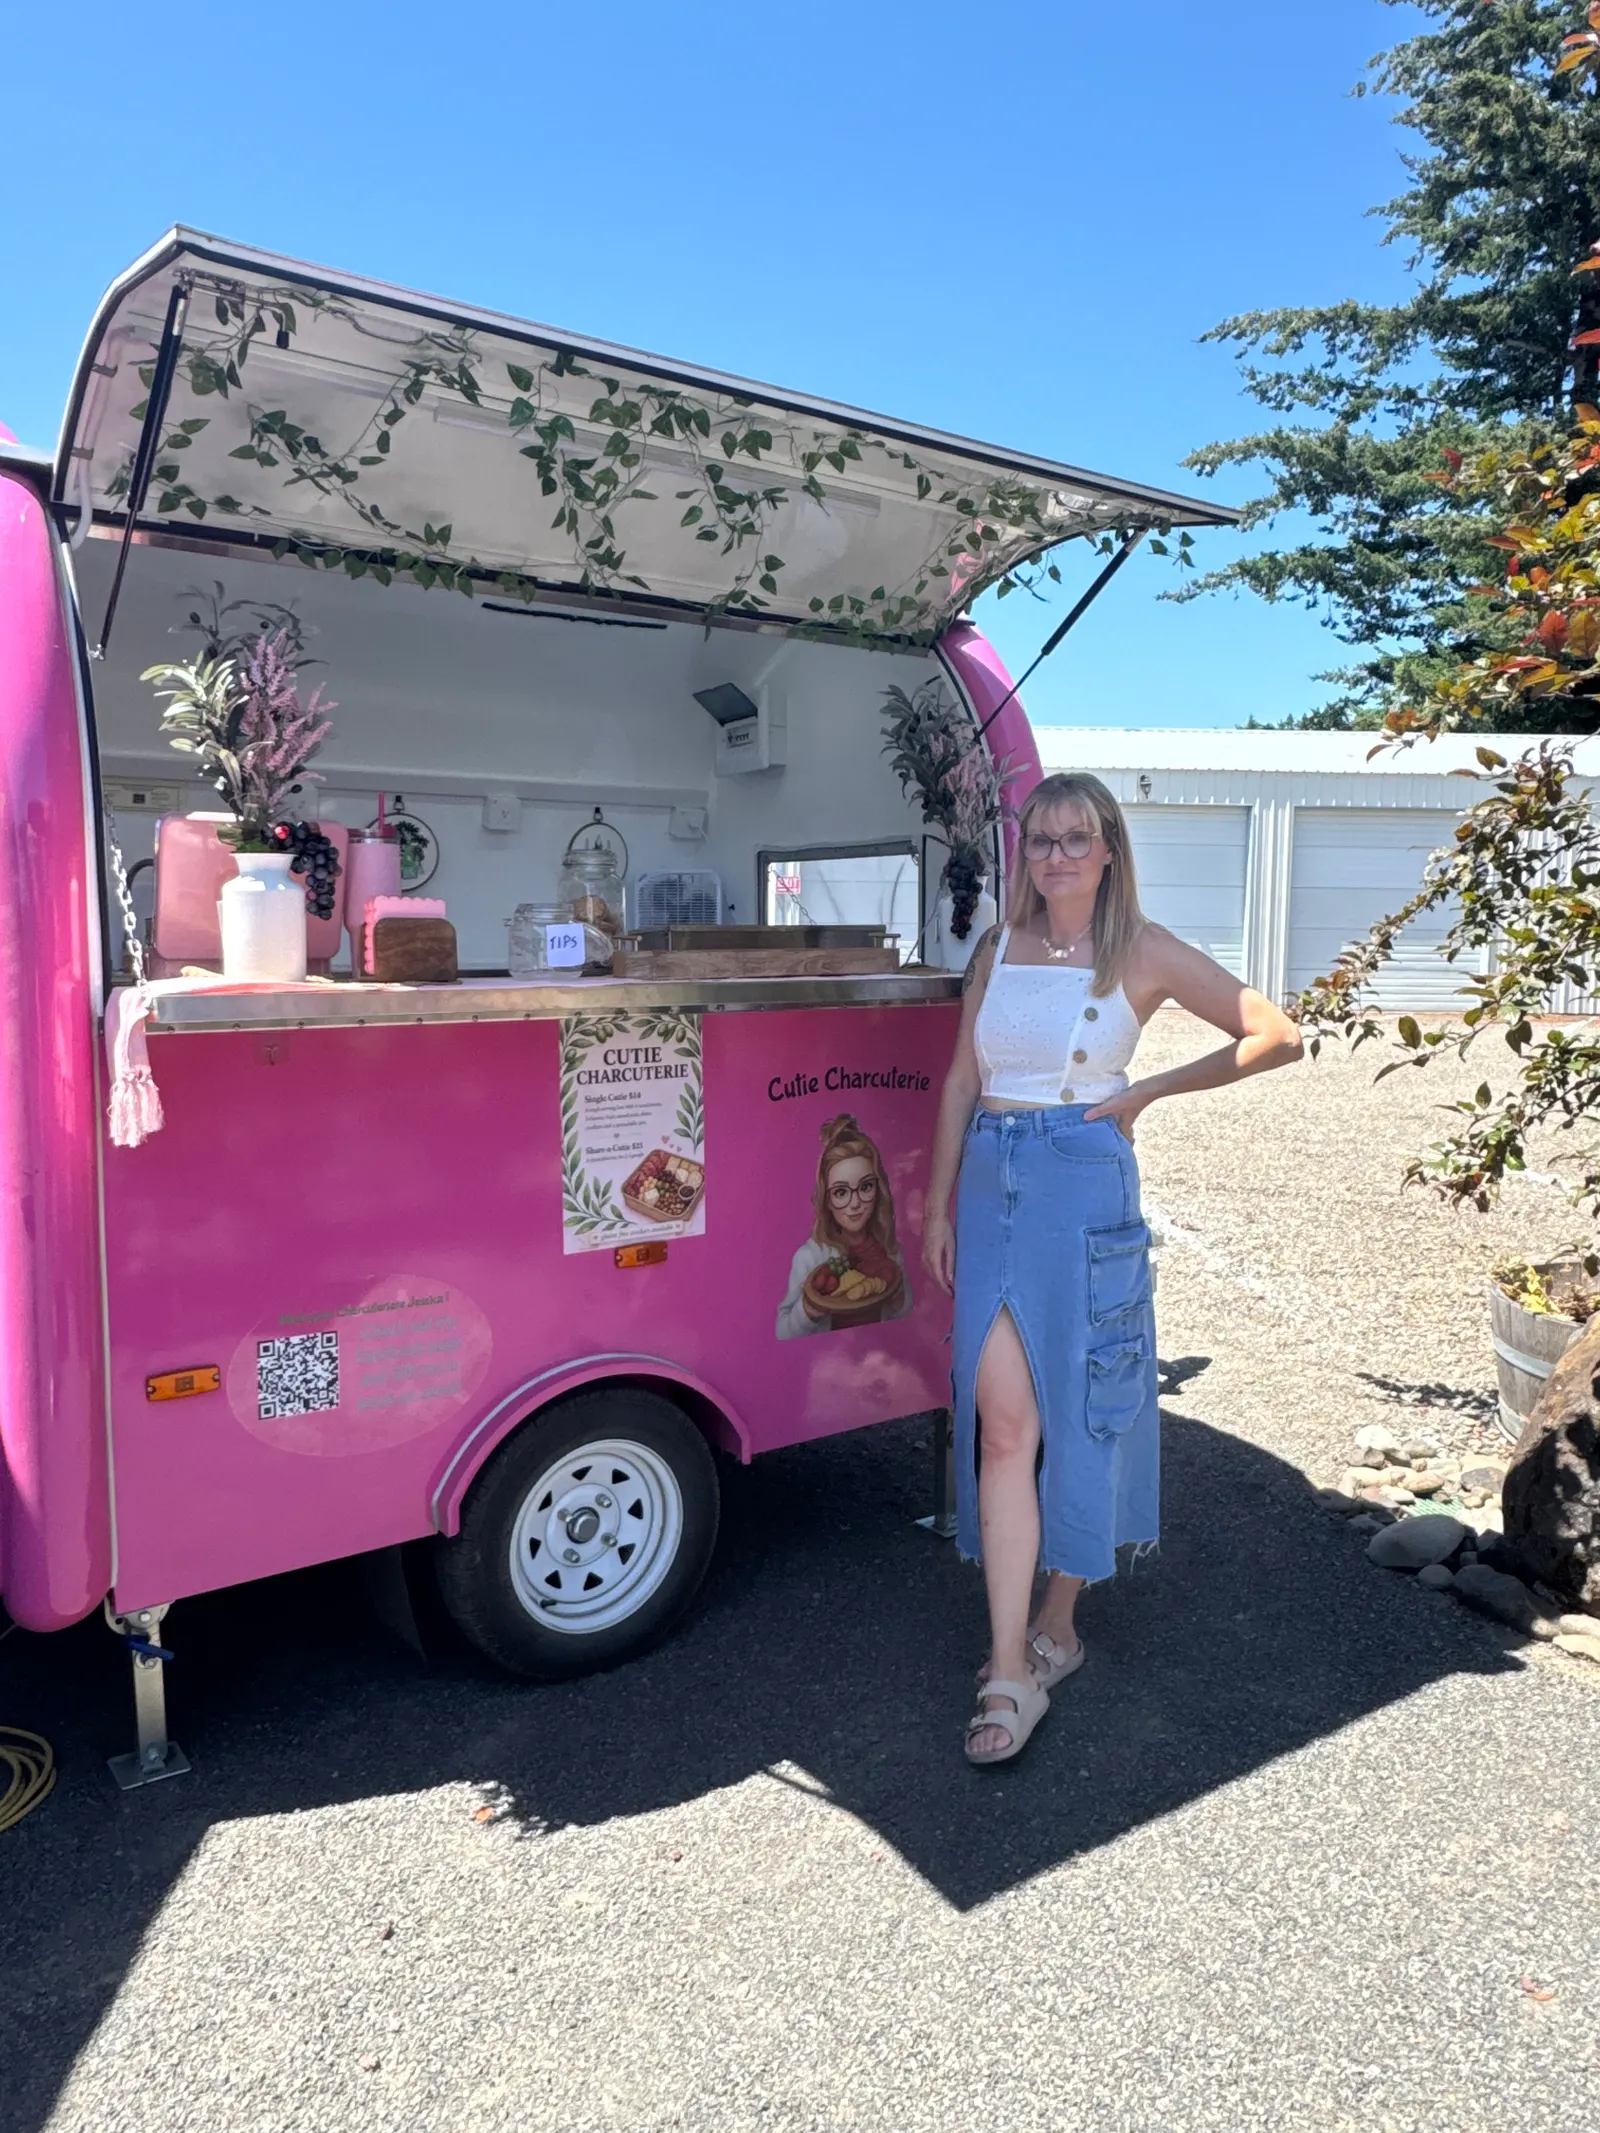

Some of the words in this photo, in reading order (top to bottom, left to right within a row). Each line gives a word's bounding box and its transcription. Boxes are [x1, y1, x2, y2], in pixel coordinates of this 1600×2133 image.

[549, 934, 578, 950] TIPS
[603, 1046, 662, 1066] CUTIE
[576, 1063, 689, 1085] CHARCUTERIE
[768, 1073, 819, 1102] Cutie
[824, 1066, 931, 1091] Charcuterie
[608, 1092, 628, 1102] Cutie
